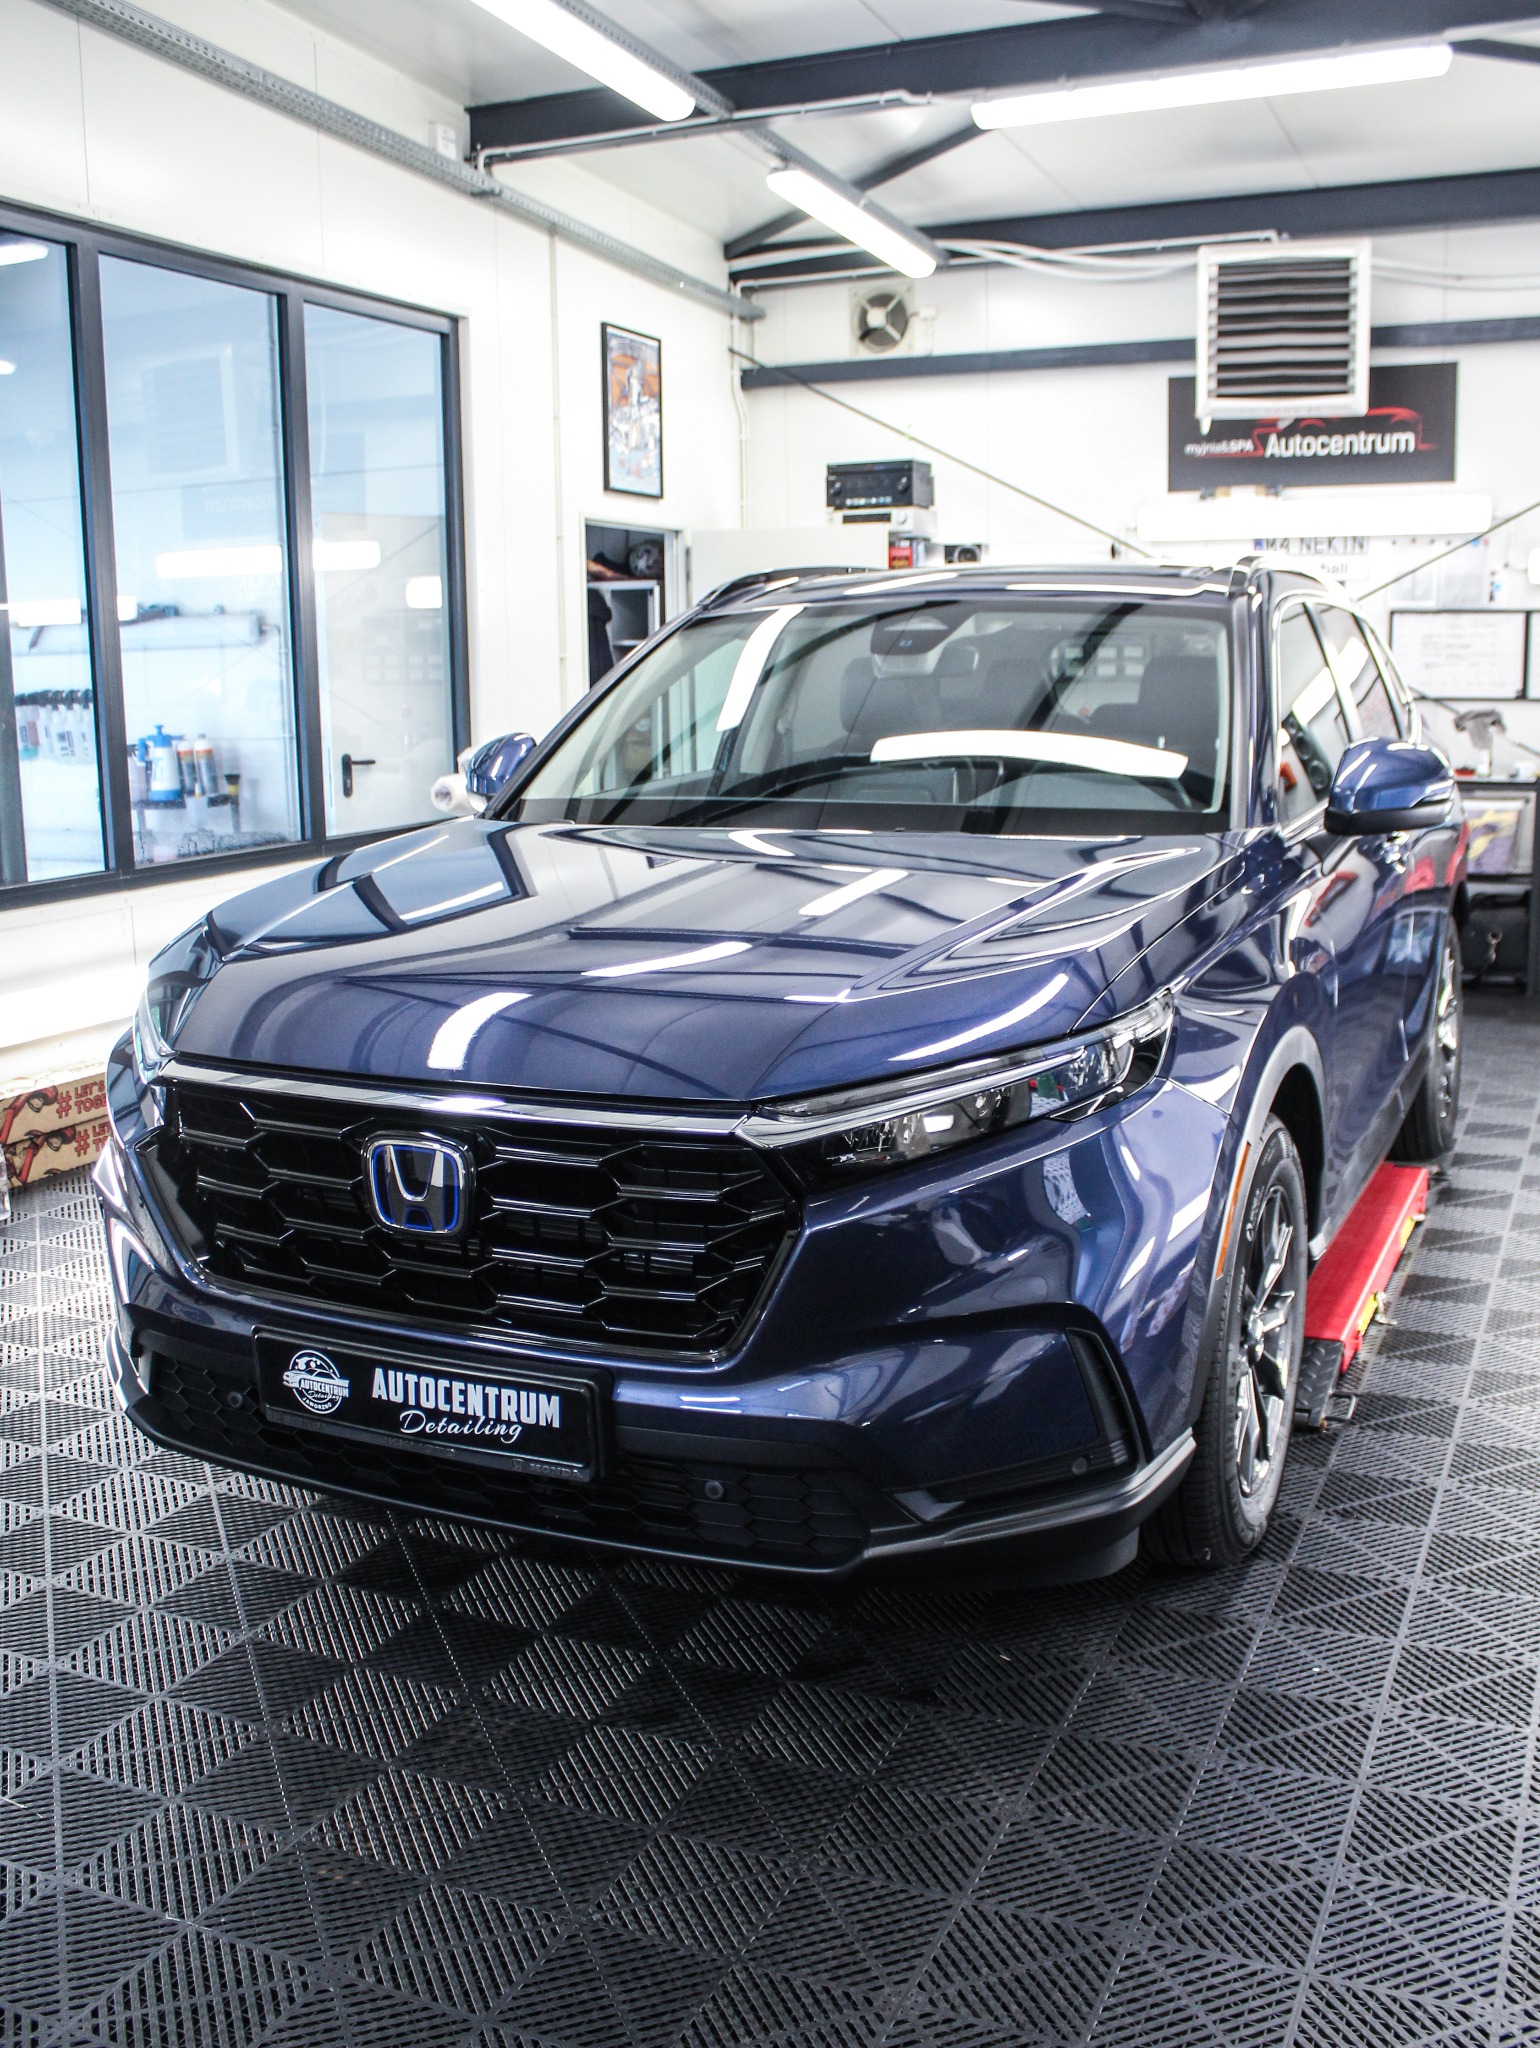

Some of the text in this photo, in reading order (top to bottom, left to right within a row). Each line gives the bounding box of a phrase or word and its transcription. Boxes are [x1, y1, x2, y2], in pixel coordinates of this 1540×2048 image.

[1264, 430, 1415, 458] Autocentrum
[75, 1080, 105, 1099] LET'S
[300, 1378, 349, 1398] AUTOCENTRUM
[372, 1367, 560, 1428] AUTOCENTRUM
[400, 1410, 522, 1444] Detailing
